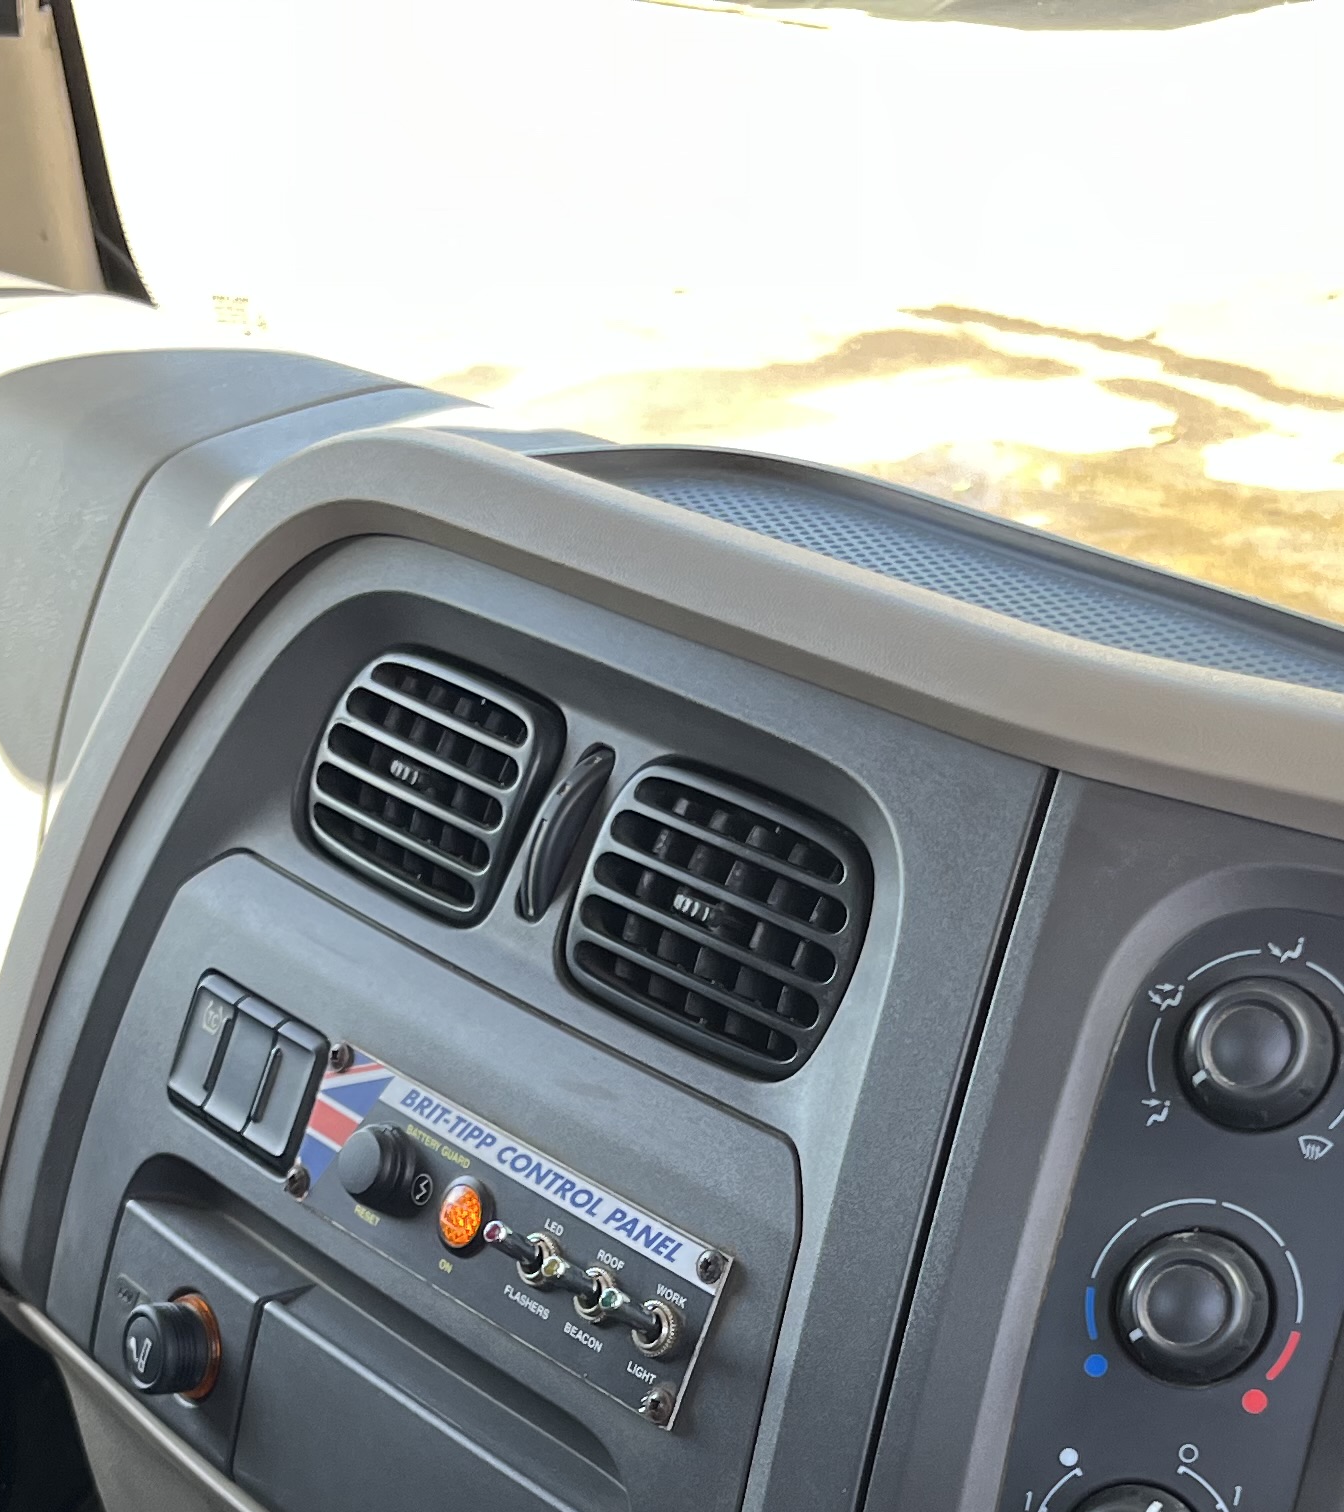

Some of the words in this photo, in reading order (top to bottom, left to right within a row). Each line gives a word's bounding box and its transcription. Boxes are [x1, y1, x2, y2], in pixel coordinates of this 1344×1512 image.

[406, 1124, 441, 1152] BATTERY
[441, 1145, 471, 1169] GUARD
[400, 1089, 497, 1149] BRIT-TIPP
[497, 1146, 604, 1218] CONTROL
[603, 1207, 683, 1263] PANEL
[354, 1204, 381, 1227] RESET
[544, 1217, 565, 1237] LED
[438, 1258, 454, 1274] ON
[596, 1249, 625, 1271] ROOF
[503, 1284, 551, 1321] FLASHERS
[656, 1283, 688, 1309] WORK
[563, 1321, 604, 1353] BEACON
[626, 1360, 657, 1386] LIGHT
[1024, 1490, 1033, 1512] 1
[1233, 1484, 1243, 1506] 1
